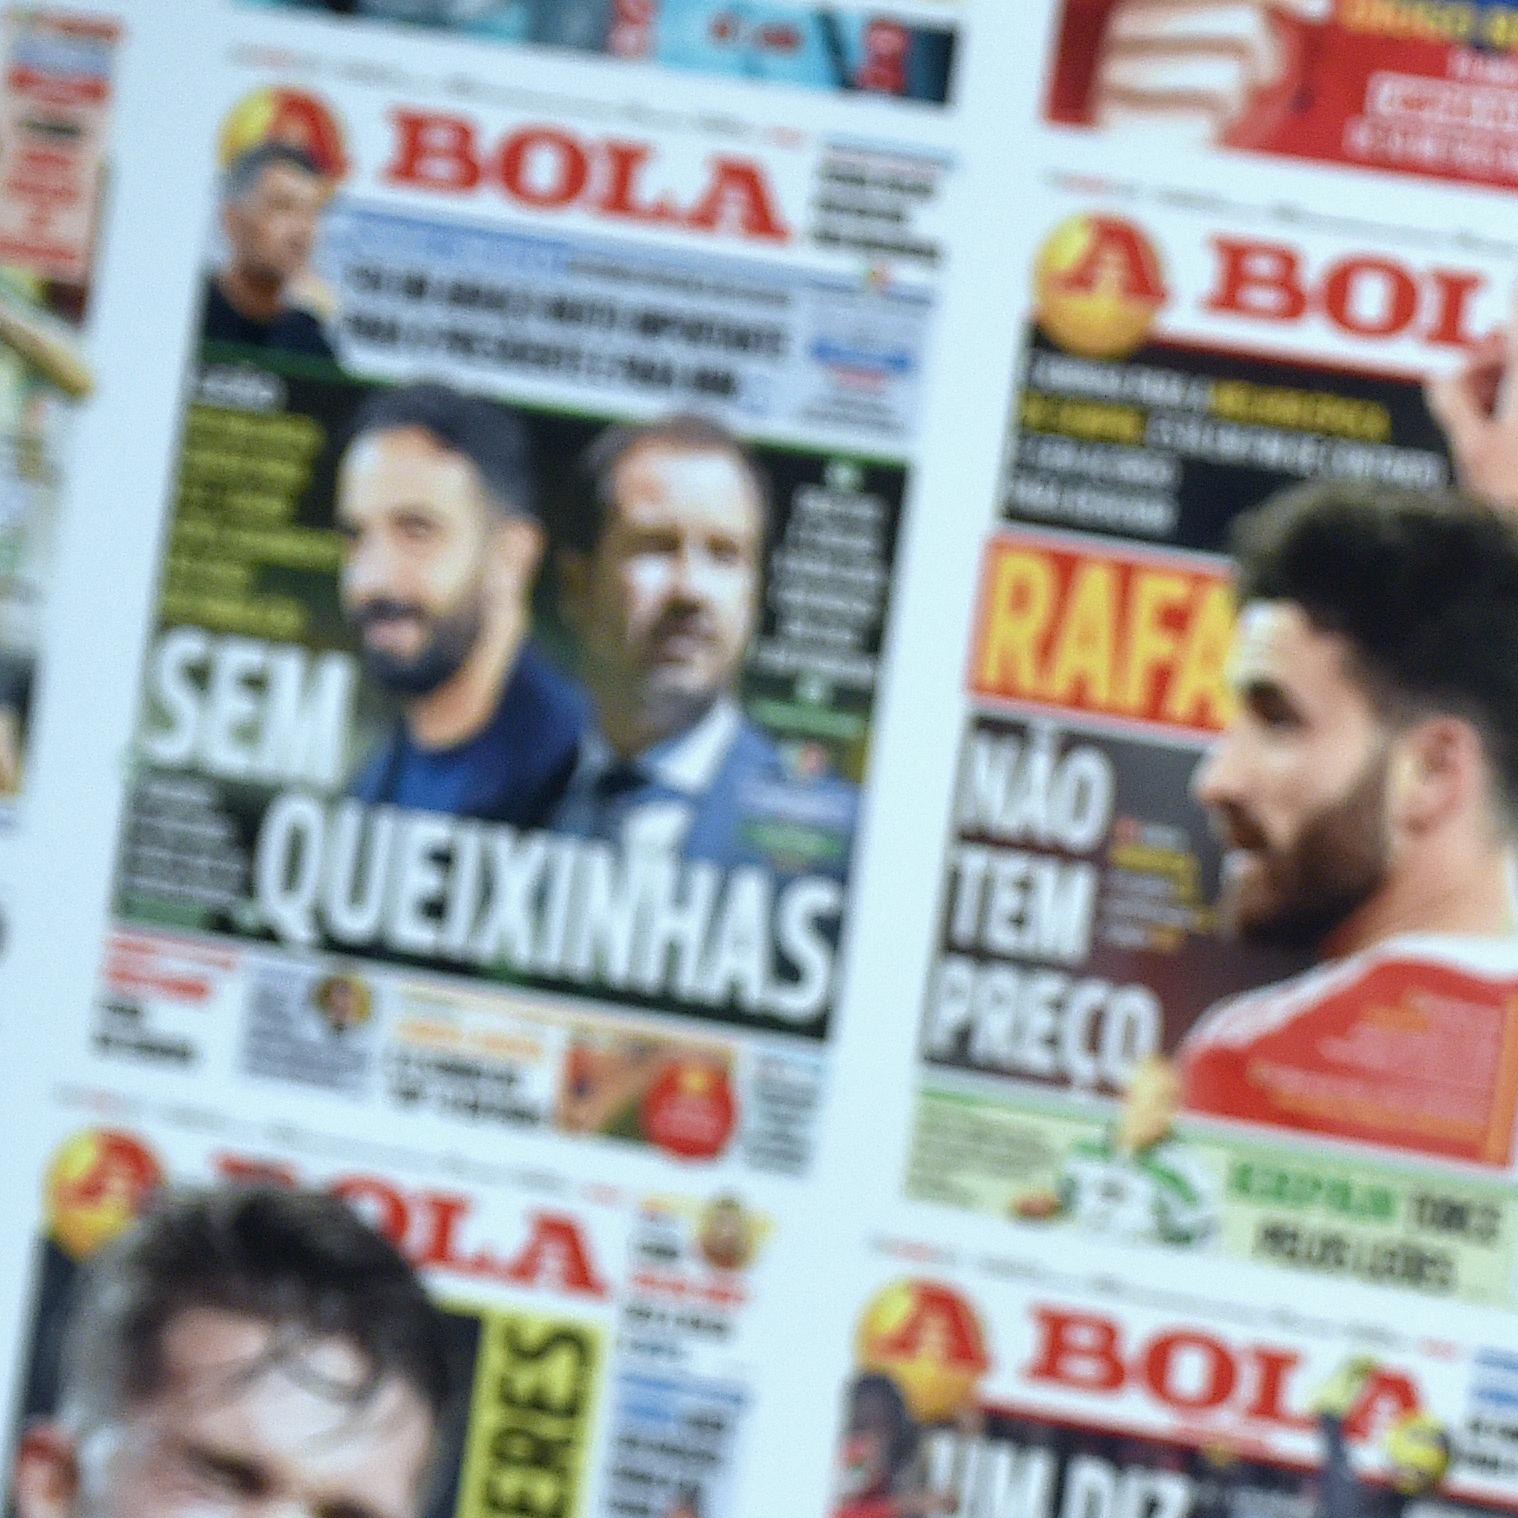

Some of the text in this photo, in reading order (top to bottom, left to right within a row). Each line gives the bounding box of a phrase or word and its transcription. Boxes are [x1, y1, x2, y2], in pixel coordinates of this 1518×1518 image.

[386, 106, 791, 244] BOLA
[1052, 212, 1170, 298] A
[147, 628, 359, 788] SEM
[978, 551, 1236, 734] RAFA
[959, 725, 1116, 850] NÃO
[254, 796, 850, 1017] QUEIXINHAS
[948, 842, 1098, 967] TEM
[928, 952, 1163, 1084] PREÇO
[215, 1152, 608, 1298] OLA
[867, 1280, 988, 1368] A
[1027, 1304, 1423, 1440] BOLA
